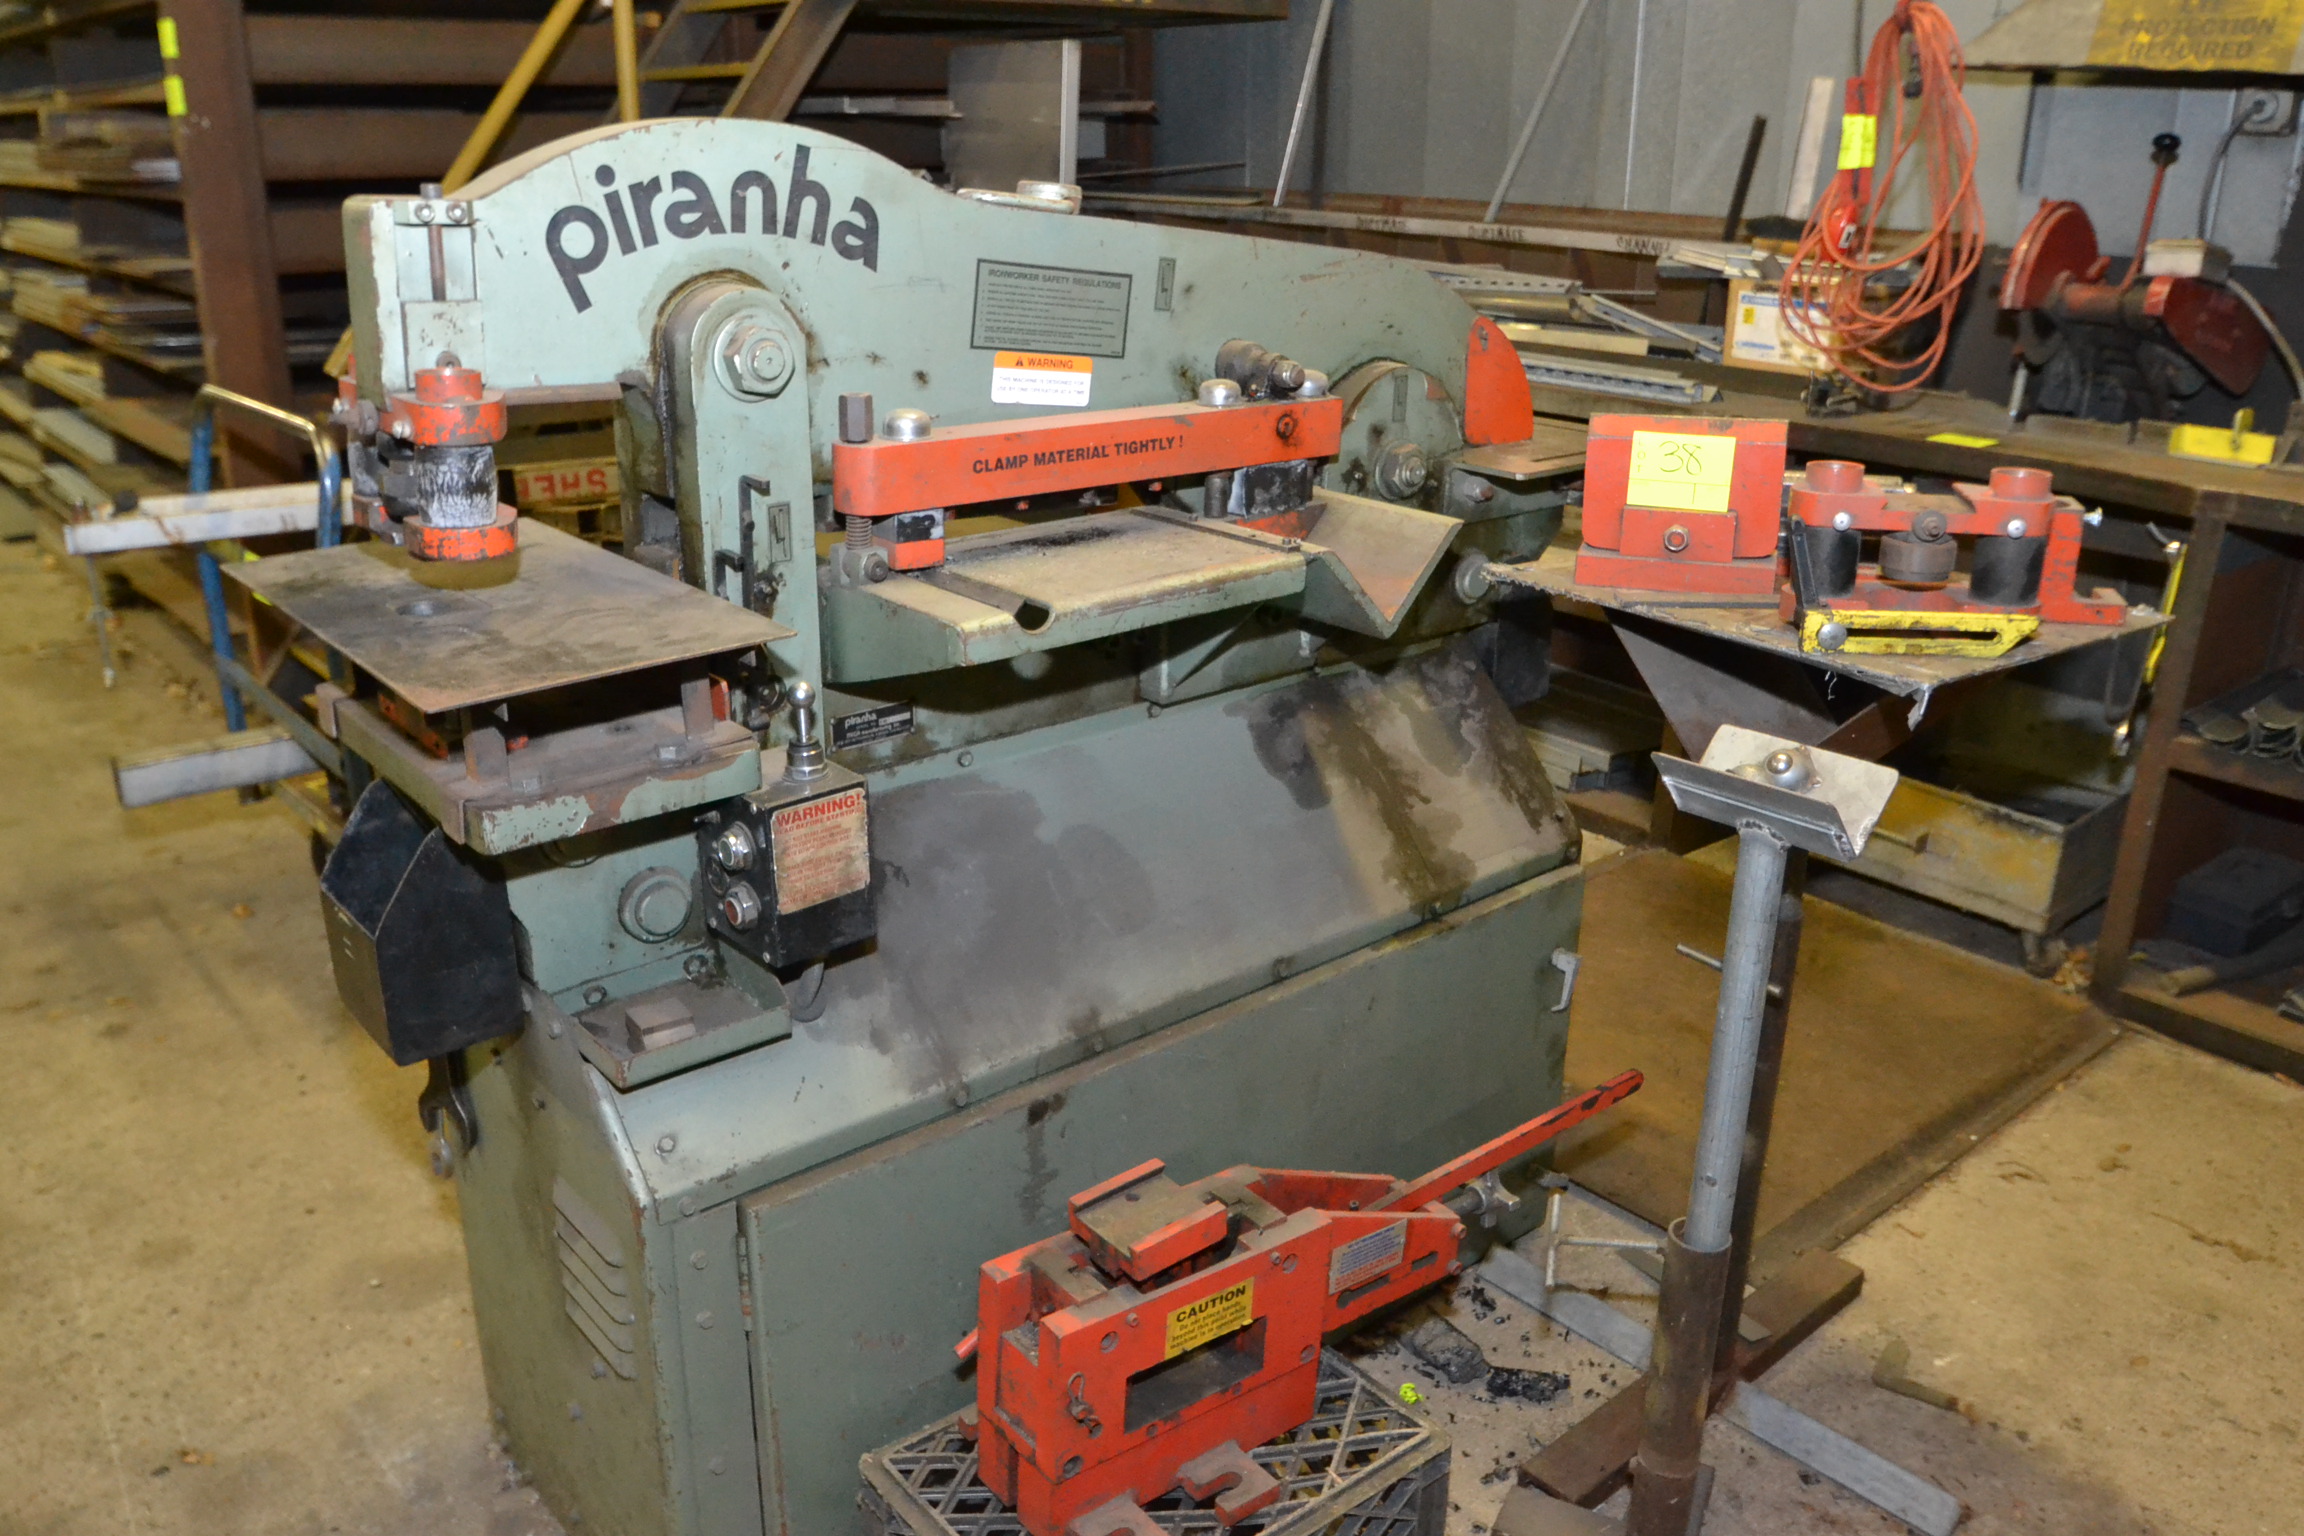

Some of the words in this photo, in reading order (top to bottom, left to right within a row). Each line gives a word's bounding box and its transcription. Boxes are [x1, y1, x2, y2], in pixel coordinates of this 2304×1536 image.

[545, 143, 880, 315] piranha
[988, 268, 1039, 281] IRONWORKER
[1041, 274, 1070, 285] SAFETY
[1072, 278, 1122, 290] REGULATIONS
[1027, 357, 1074, 370] WARNING
[973, 454, 1029, 474] CLAMP
[1033, 445, 1110, 467] MATERIAL
[1114, 436, 1176, 457] TIGHTLY
[1659, 440, 1702, 476] 38
[845, 711, 877, 730] piranha
[776, 793, 861, 827] WARNING!
[1176, 1285, 1246, 1323] CAUTION
